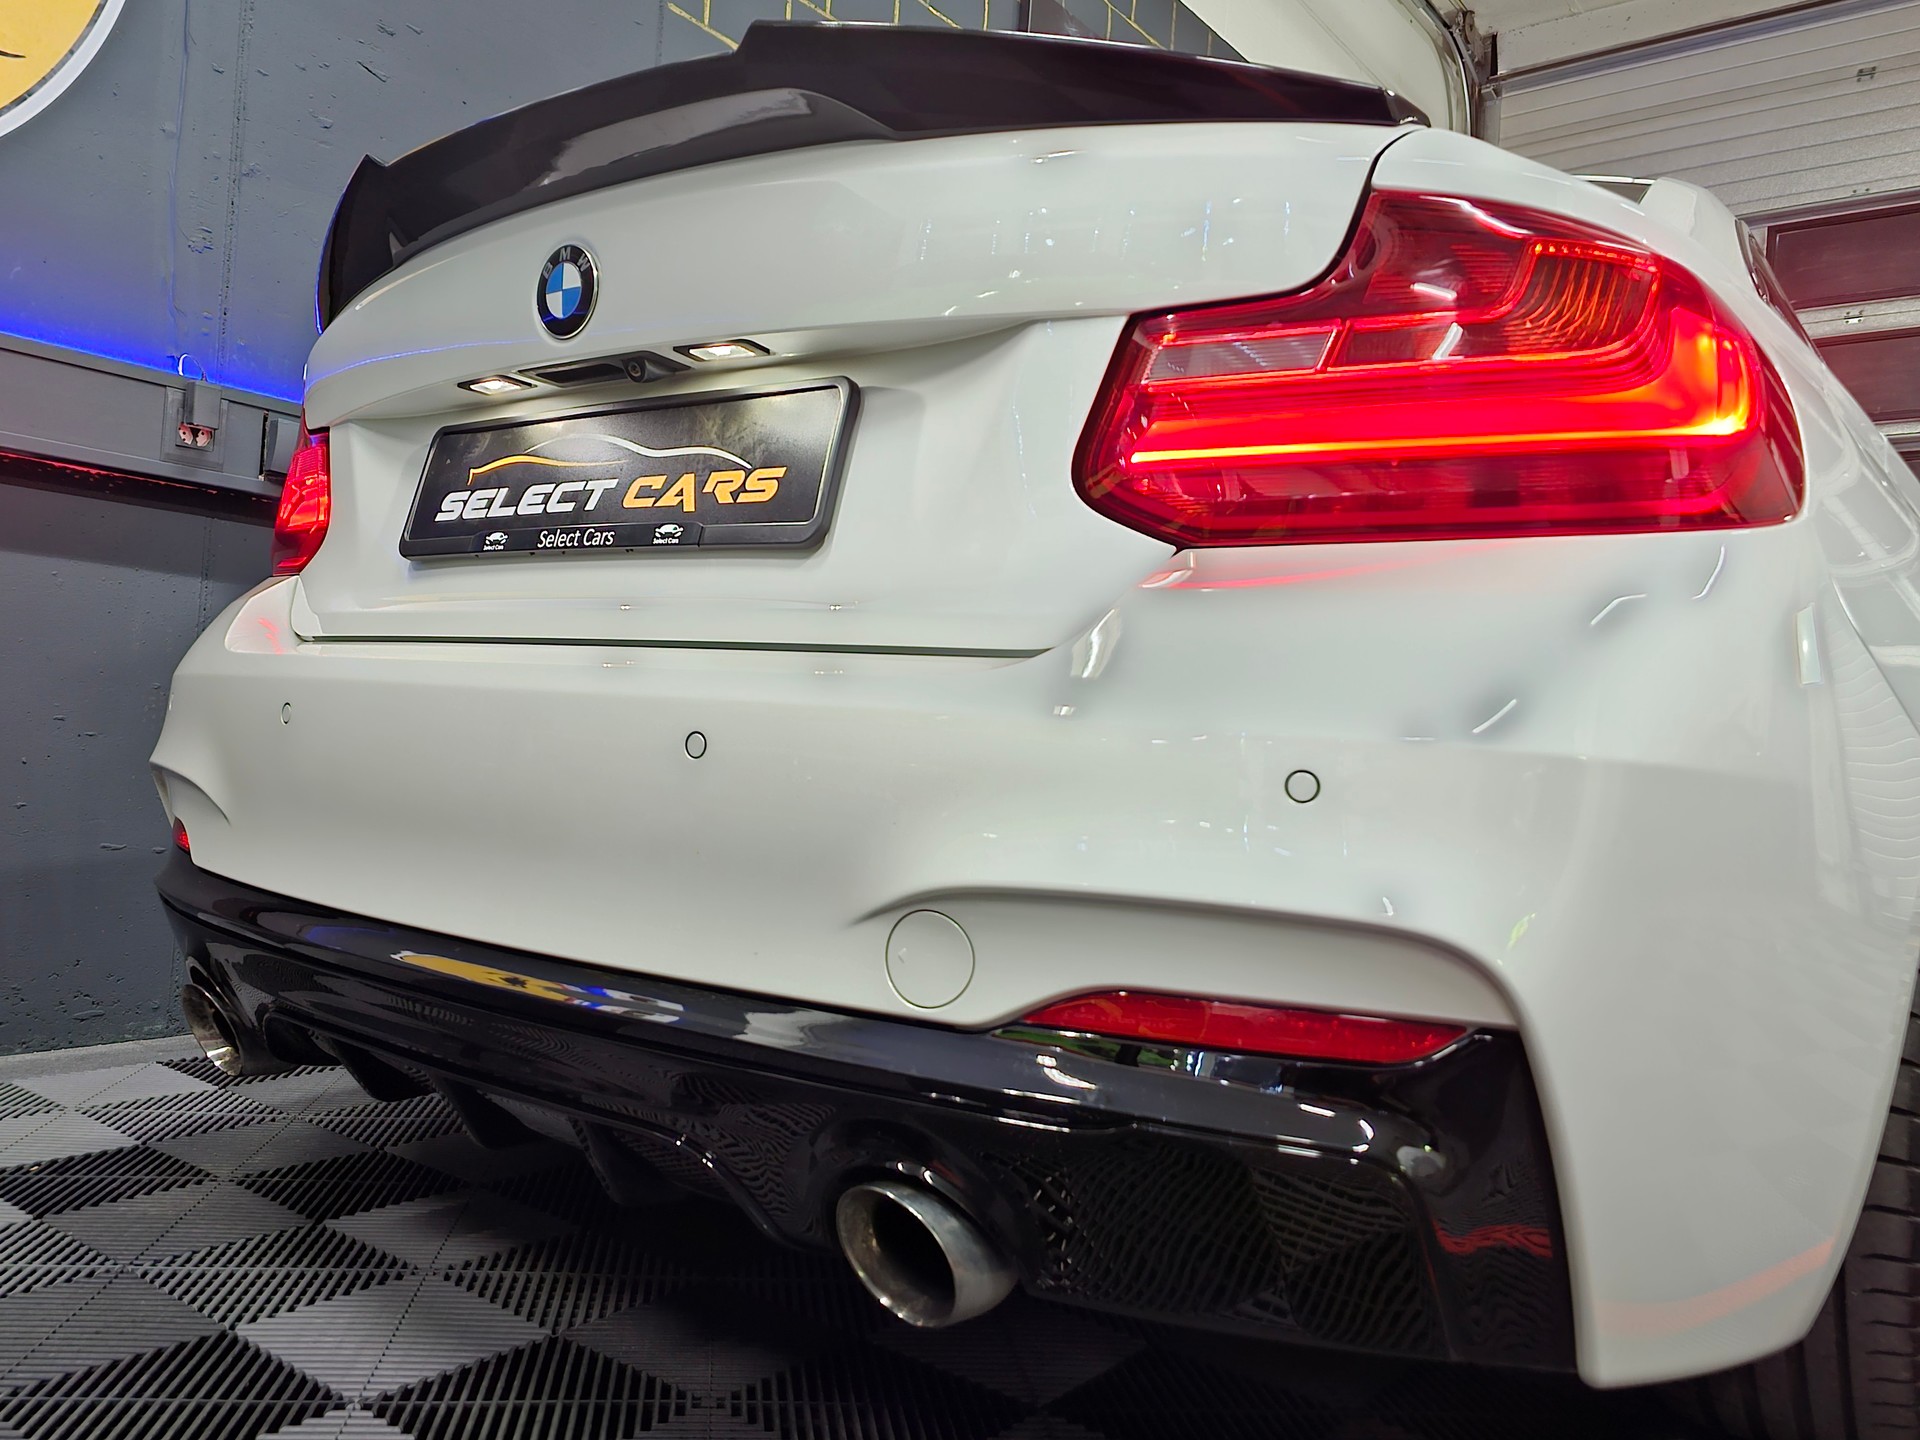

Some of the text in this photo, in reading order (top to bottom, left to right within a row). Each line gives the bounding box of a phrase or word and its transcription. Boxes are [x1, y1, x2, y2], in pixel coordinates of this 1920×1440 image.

[542, 246, 590, 279] BMW
[434, 466, 787, 522] SELECT CARS
[537, 528, 615, 548] Select Cars
